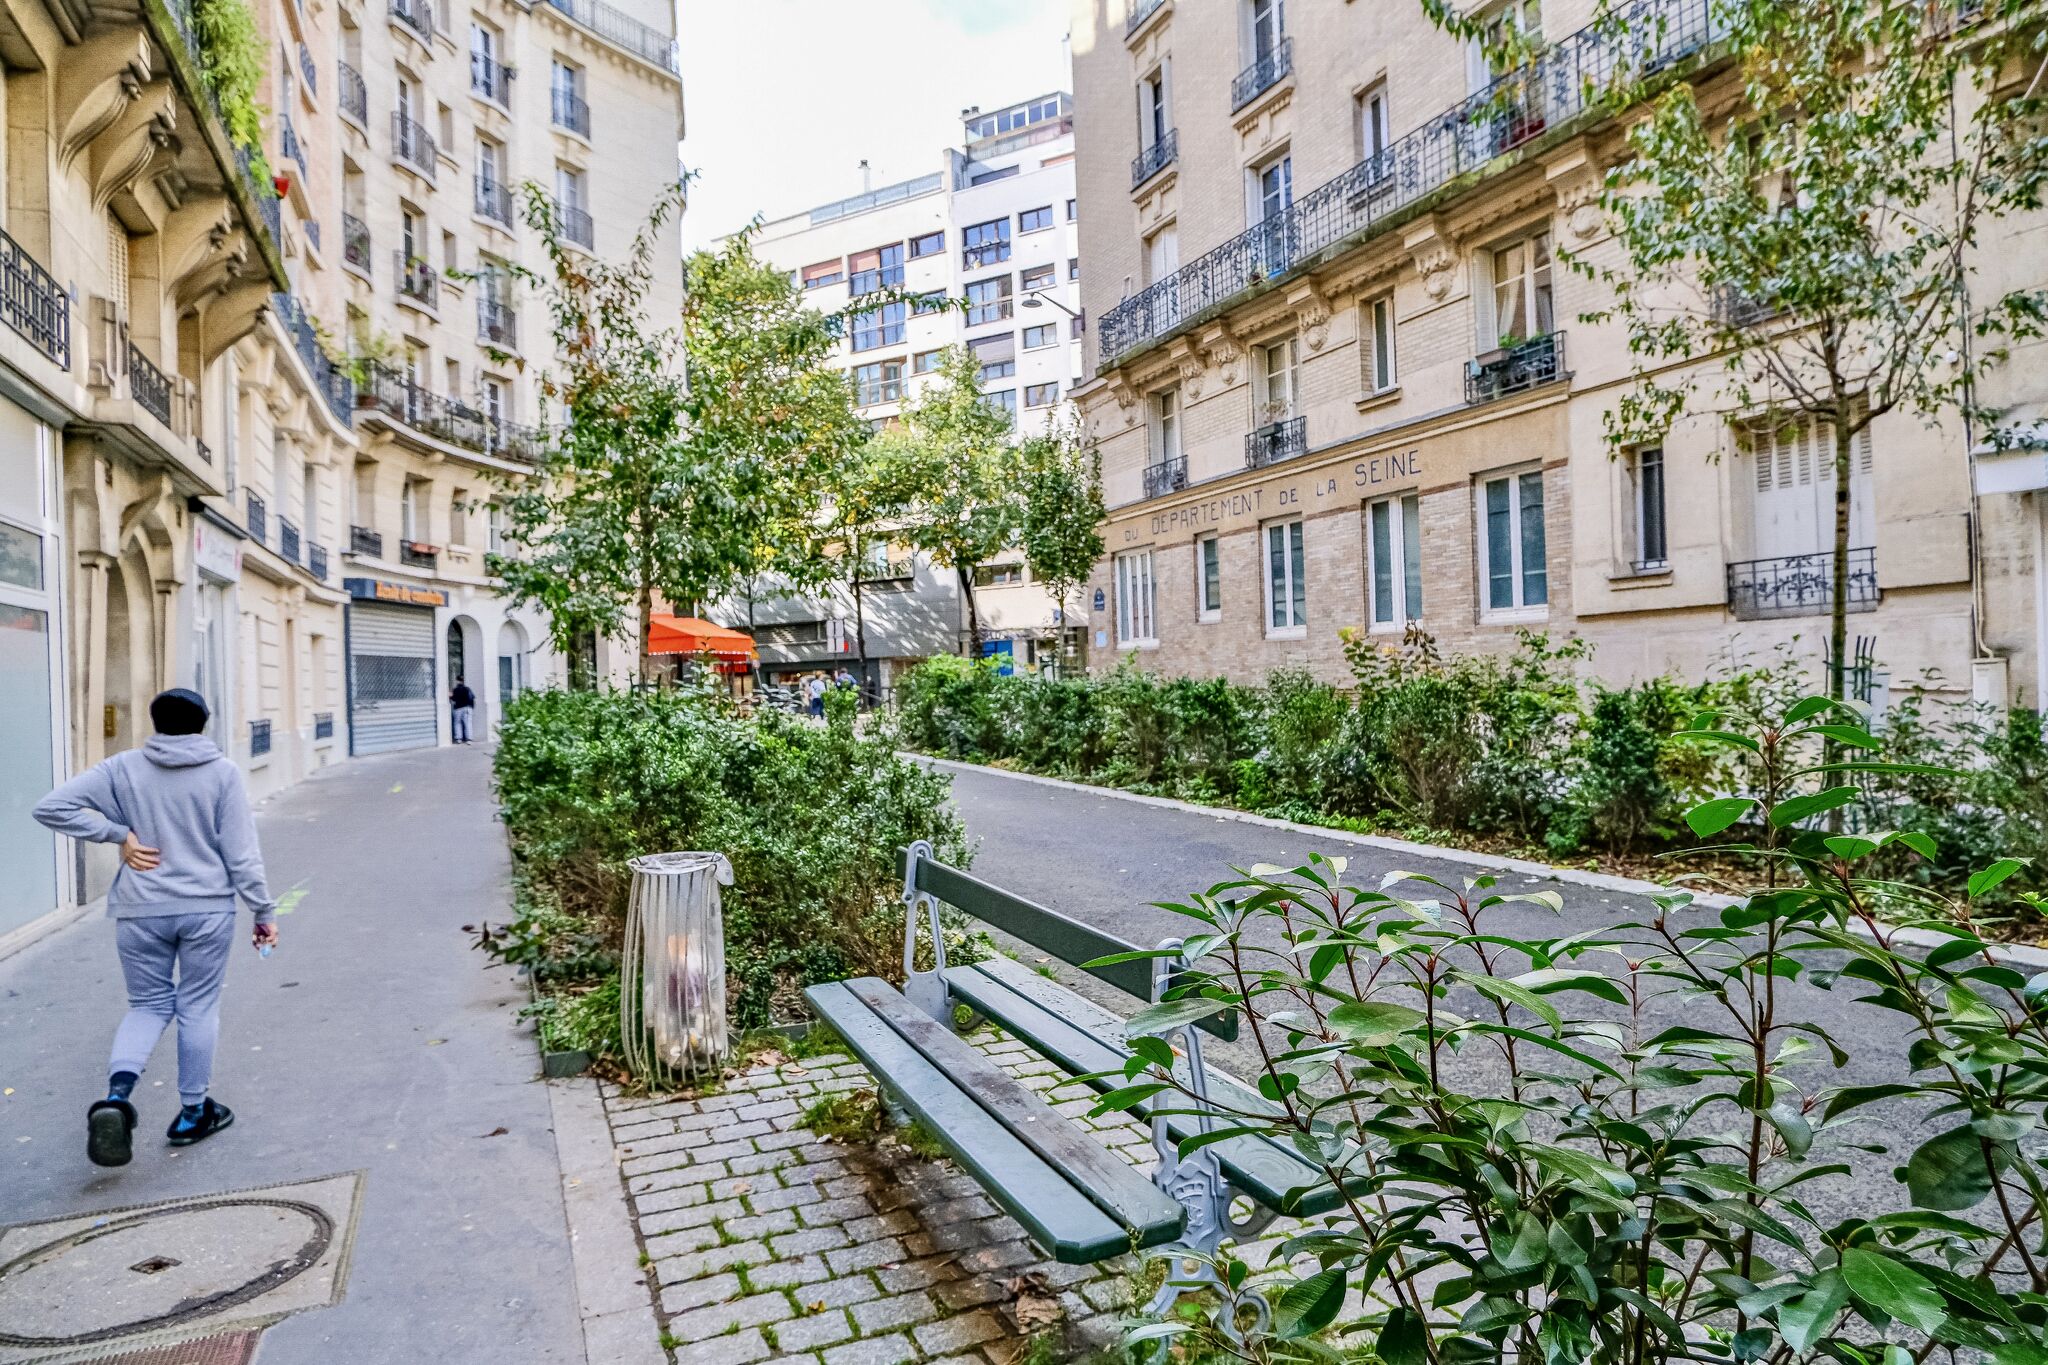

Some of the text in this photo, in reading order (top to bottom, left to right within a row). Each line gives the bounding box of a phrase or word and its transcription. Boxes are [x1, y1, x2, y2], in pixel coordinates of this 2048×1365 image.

[1124, 450, 1422, 542] DU DEPARTEMENT DE LA SEINE
